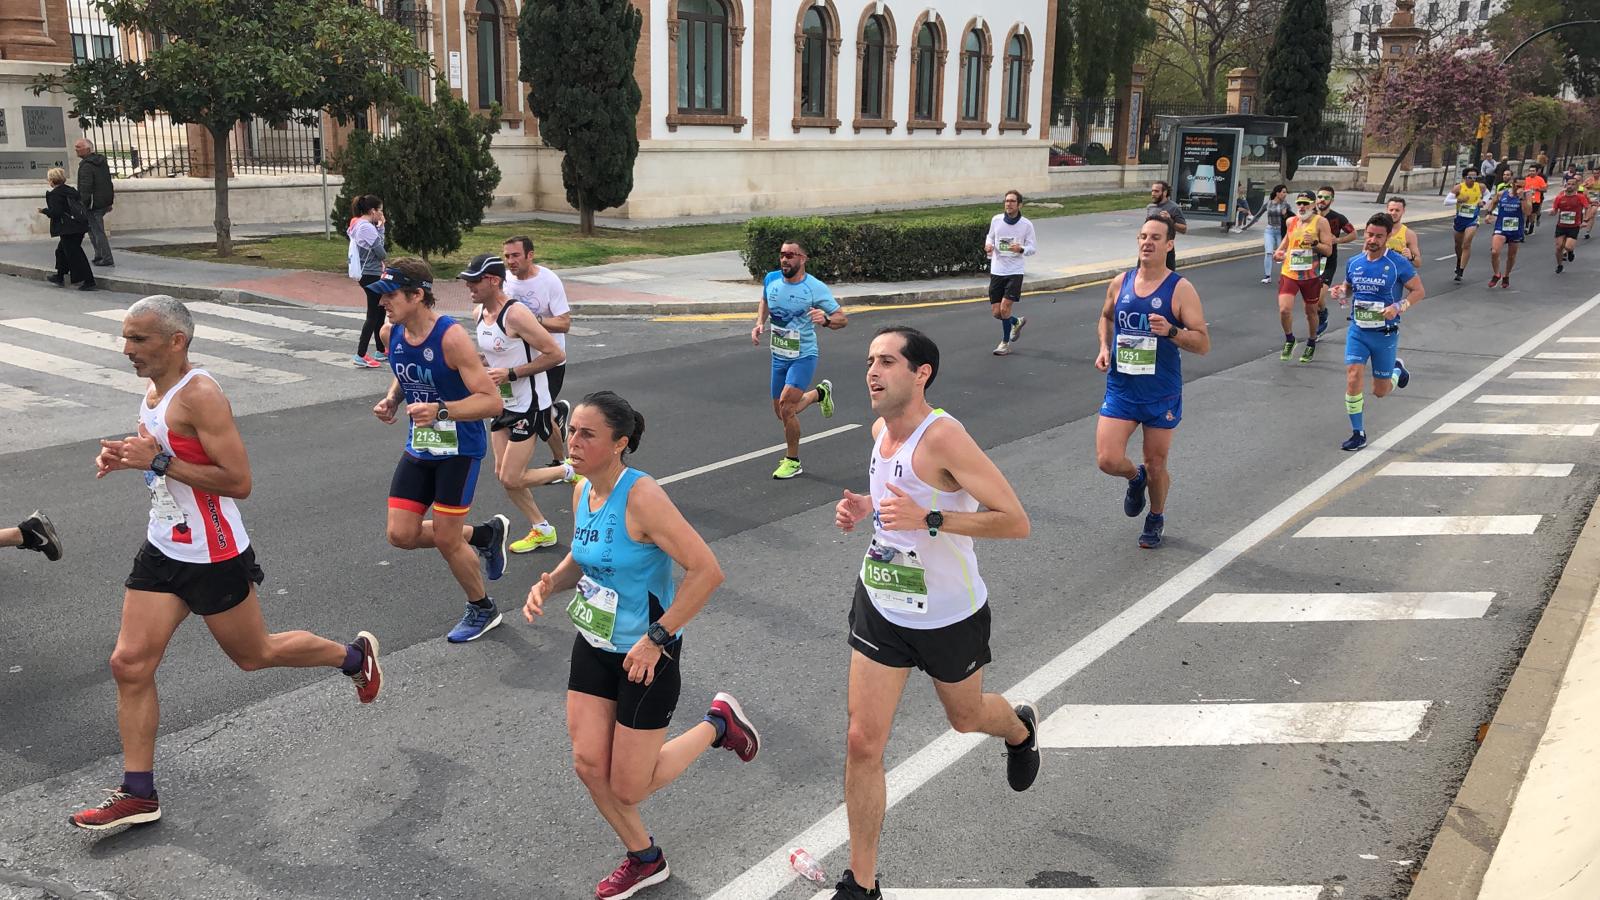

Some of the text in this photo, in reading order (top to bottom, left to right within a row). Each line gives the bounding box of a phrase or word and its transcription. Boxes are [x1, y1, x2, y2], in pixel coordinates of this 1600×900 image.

[1119, 350, 1139, 361] 1251
[395, 363, 435, 387] RCM
[416, 431, 442, 443] 2135
[867, 563, 900, 584] 1561
